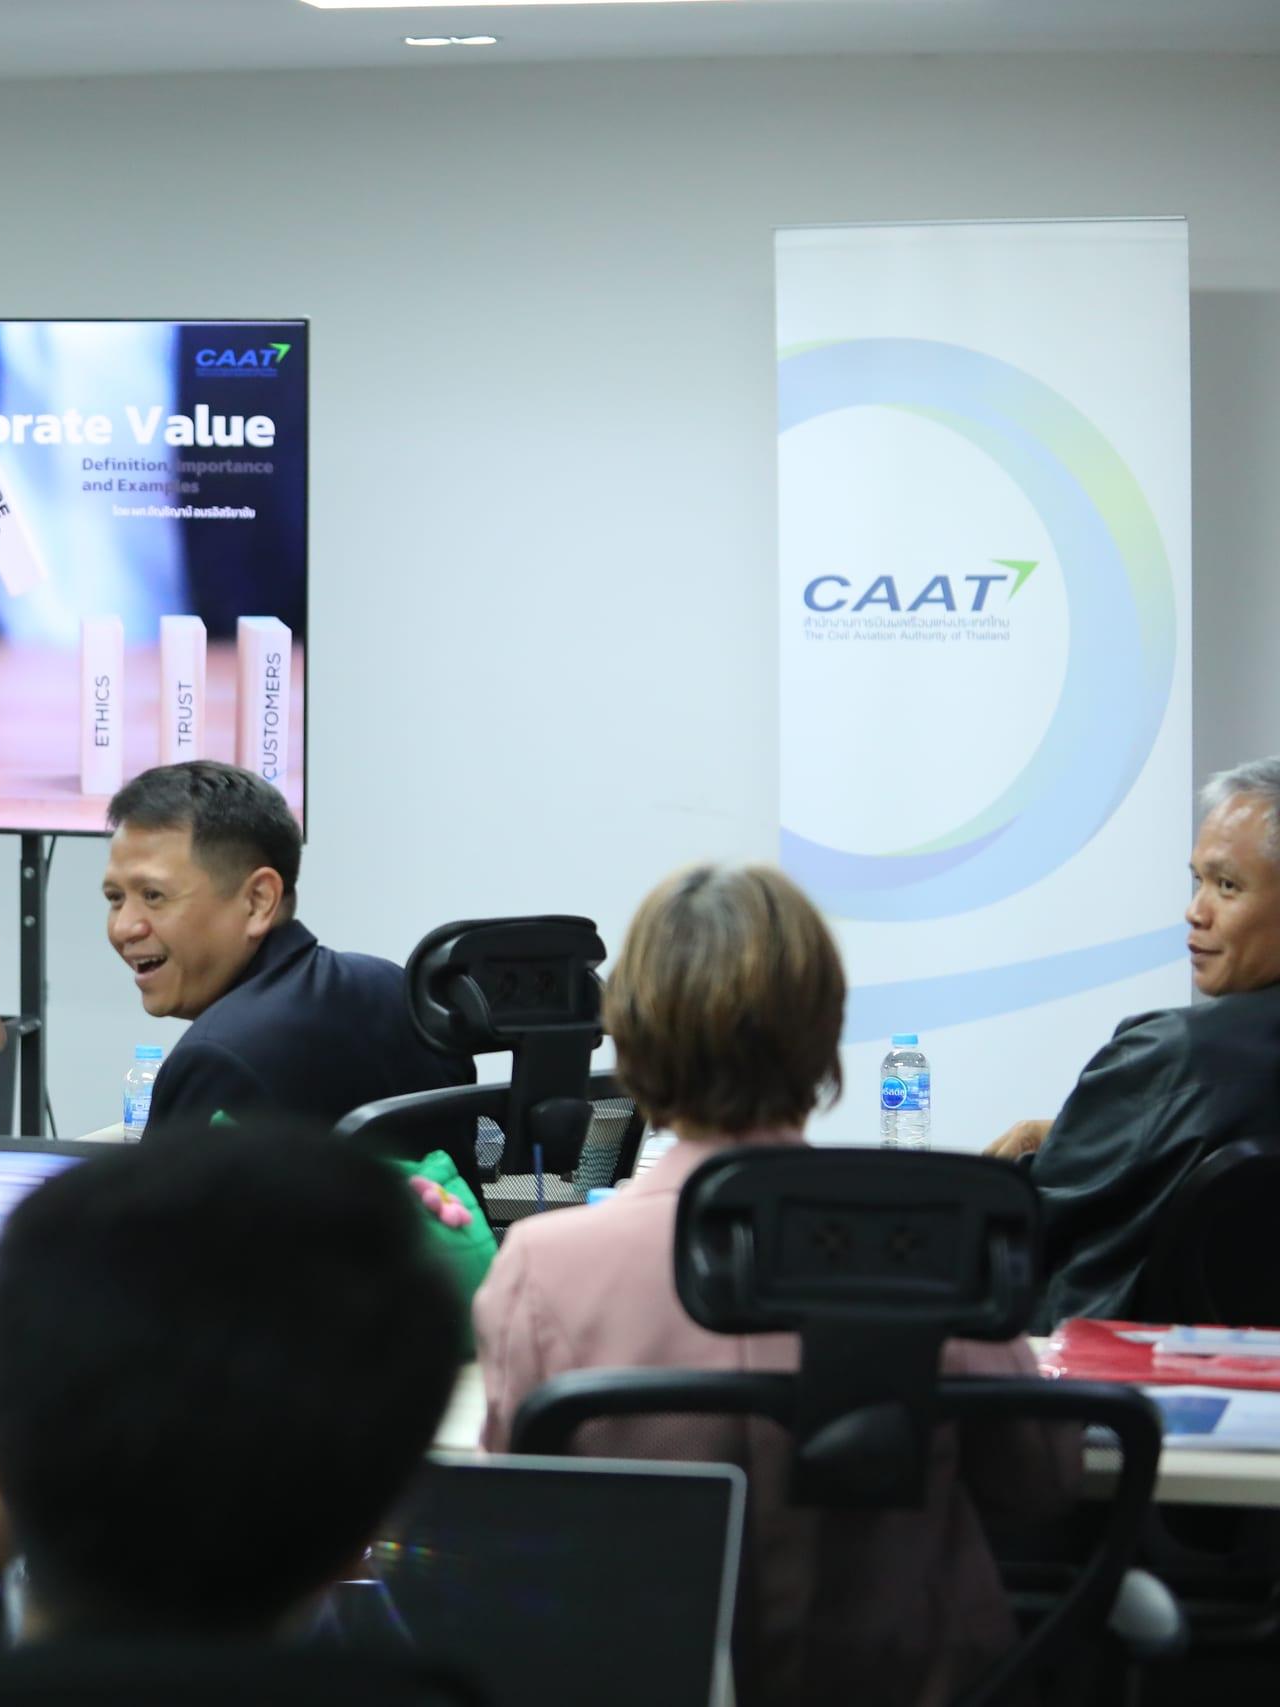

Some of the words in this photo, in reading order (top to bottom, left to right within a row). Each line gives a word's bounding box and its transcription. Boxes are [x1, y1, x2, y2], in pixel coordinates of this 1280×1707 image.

[195, 349, 277, 367] CAAT
[124, 403, 276, 447] Value
[81, 457, 170, 474] Definition,
[175, 458, 275, 478] Importance
[81, 478, 113, 492] and
[117, 478, 200, 497] Examples
[803, 574, 1008, 612] CAAT
[805, 630, 824, 641] The
[828, 630, 850, 641] Civil
[854, 630, 896, 641] Aviation
[900, 630, 946, 643] Authority
[951, 630, 961, 641] of
[965, 630, 1010, 641] Thailand
[94, 674, 110, 748] ETHICS
[177, 680, 193, 747] TRUST
[262, 651, 281, 781] CUSTOMERS
